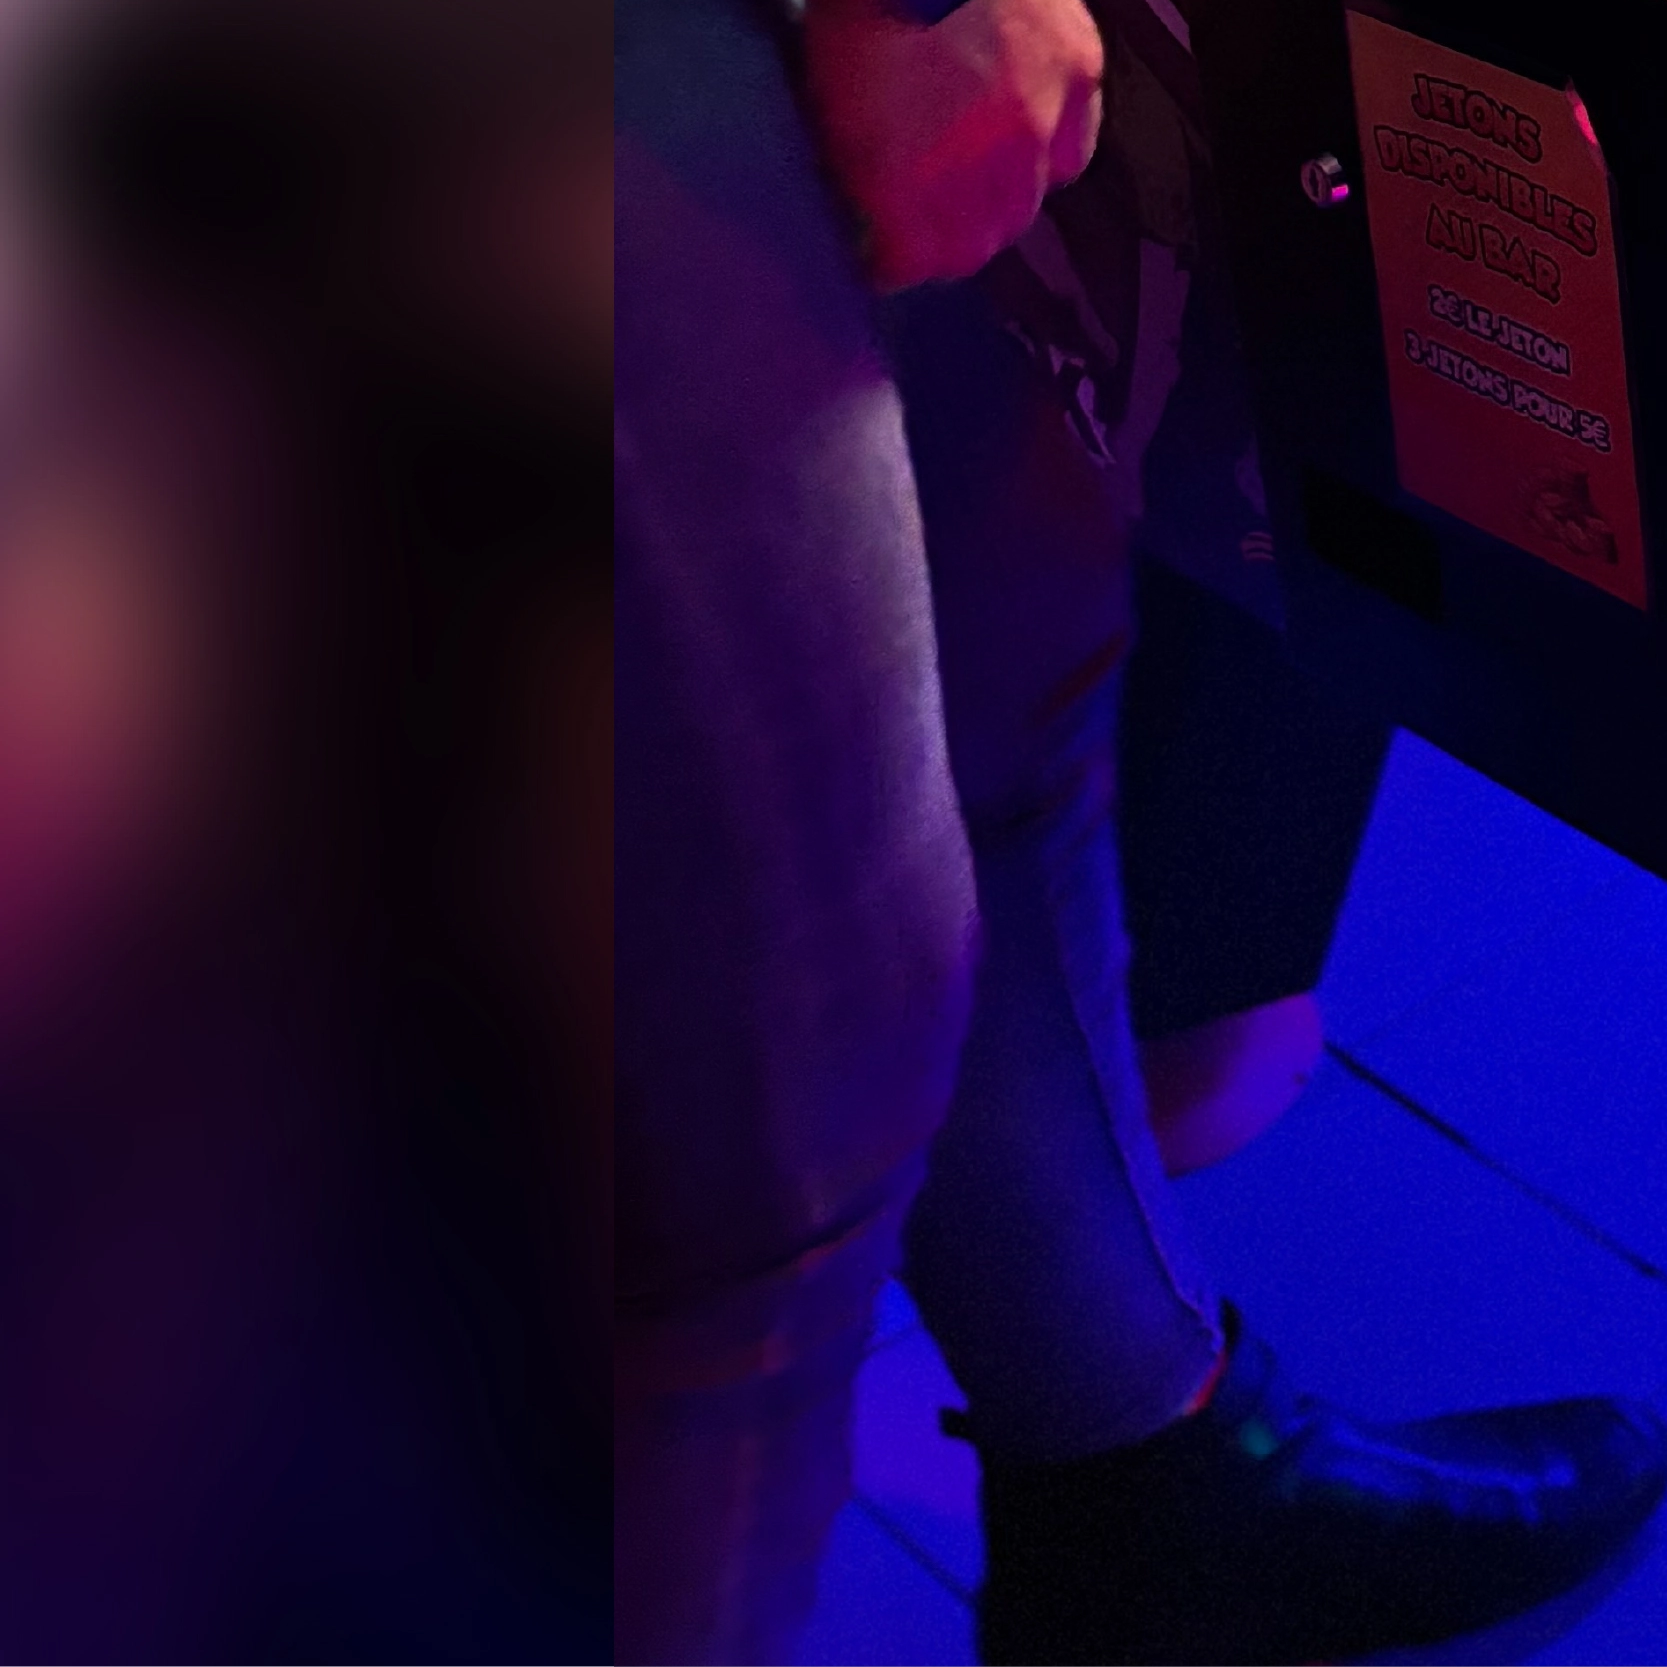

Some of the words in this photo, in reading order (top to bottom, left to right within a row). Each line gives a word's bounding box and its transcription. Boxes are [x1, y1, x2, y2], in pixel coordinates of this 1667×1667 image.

[1411, 72, 1543, 164] JETONS
[1373, 124, 1598, 257] DISPONIBLES
[1425, 202, 1477, 262] AU
[1477, 222, 1562, 305] BAR
[1404, 327, 1423, 365] 3
[1423, 339, 1511, 407] JETONS
[1511, 378, 1577, 439] POUR
[1462, 299, 1497, 342] LE
[1495, 316, 1572, 378] JETON
